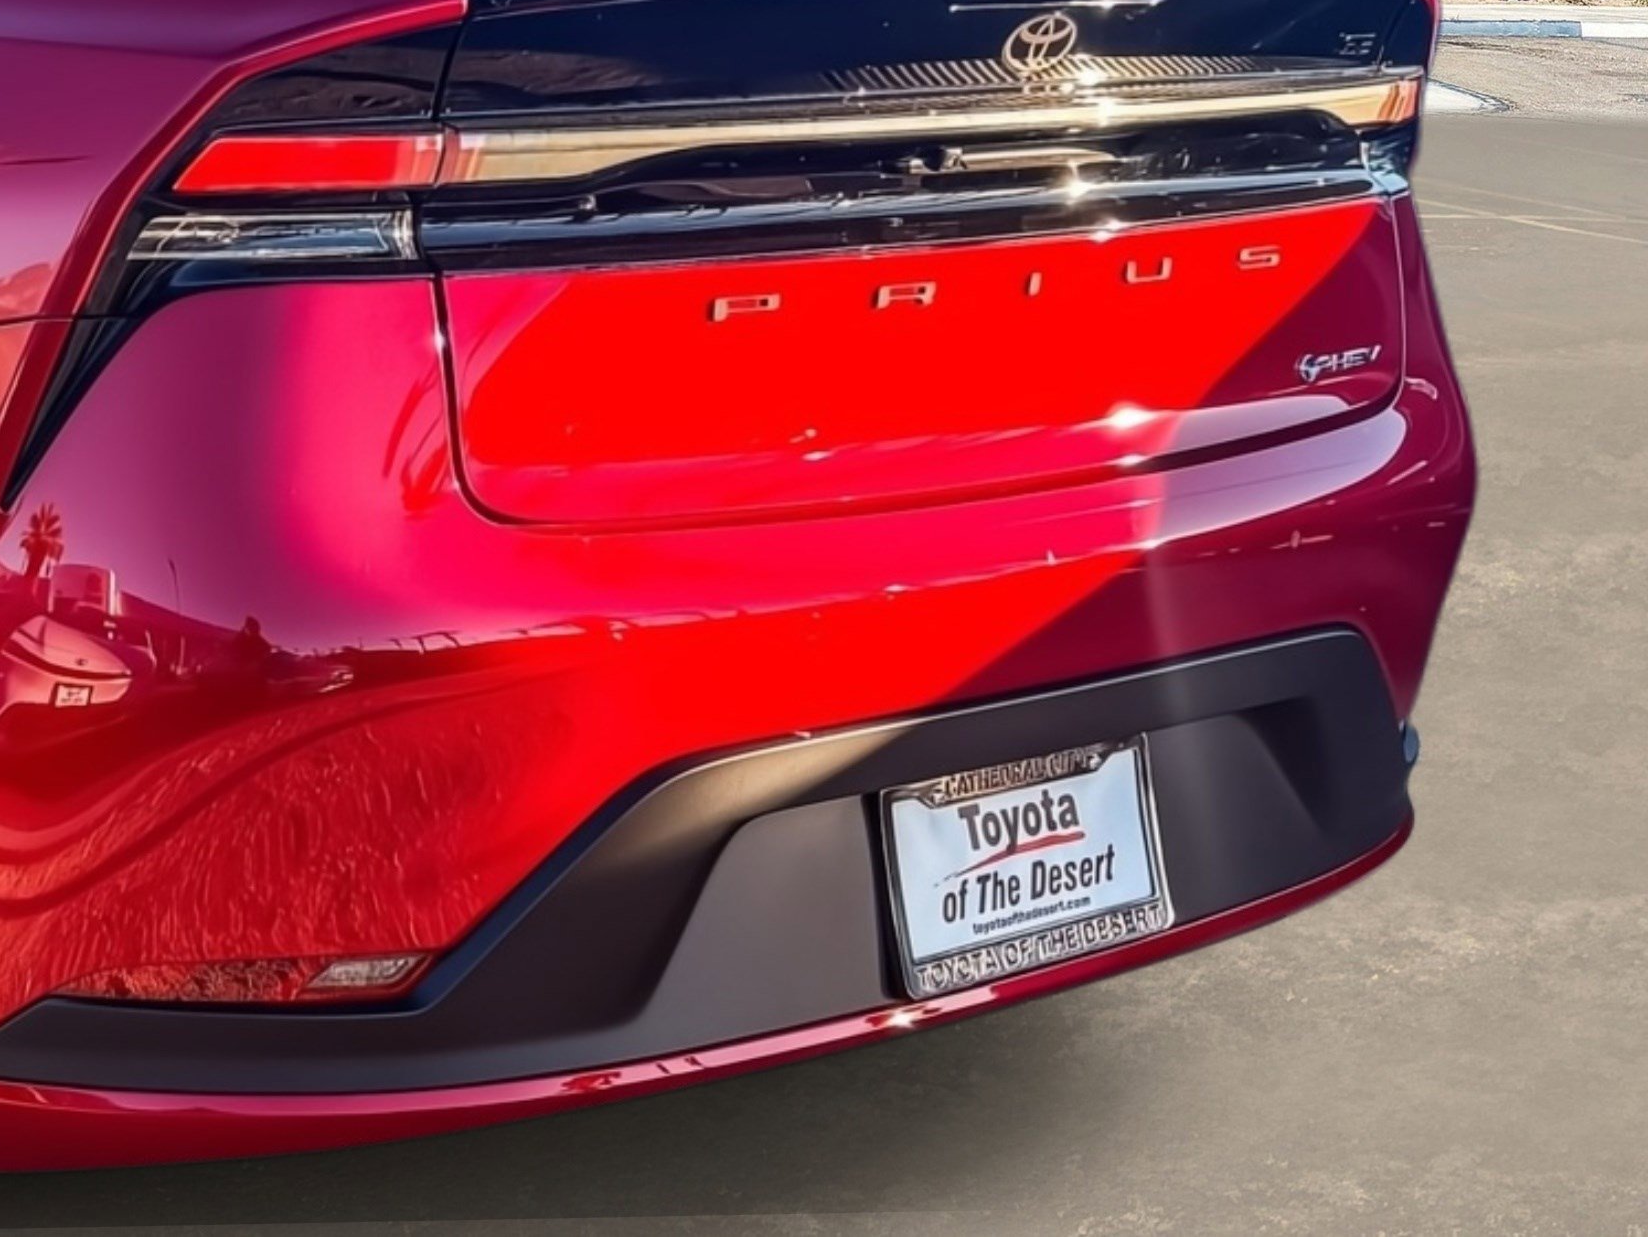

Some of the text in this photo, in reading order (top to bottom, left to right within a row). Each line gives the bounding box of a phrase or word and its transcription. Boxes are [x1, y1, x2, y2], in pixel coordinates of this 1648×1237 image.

[710, 245, 1281, 323] PRIUS
[957, 788, 1081, 854] Toyota
[942, 844, 1116, 924] of The Desert
[972, 896, 1091, 935] toyotaofthedesert.com
[916, 904, 1161, 988] TOYOTA OF THE DESERT
